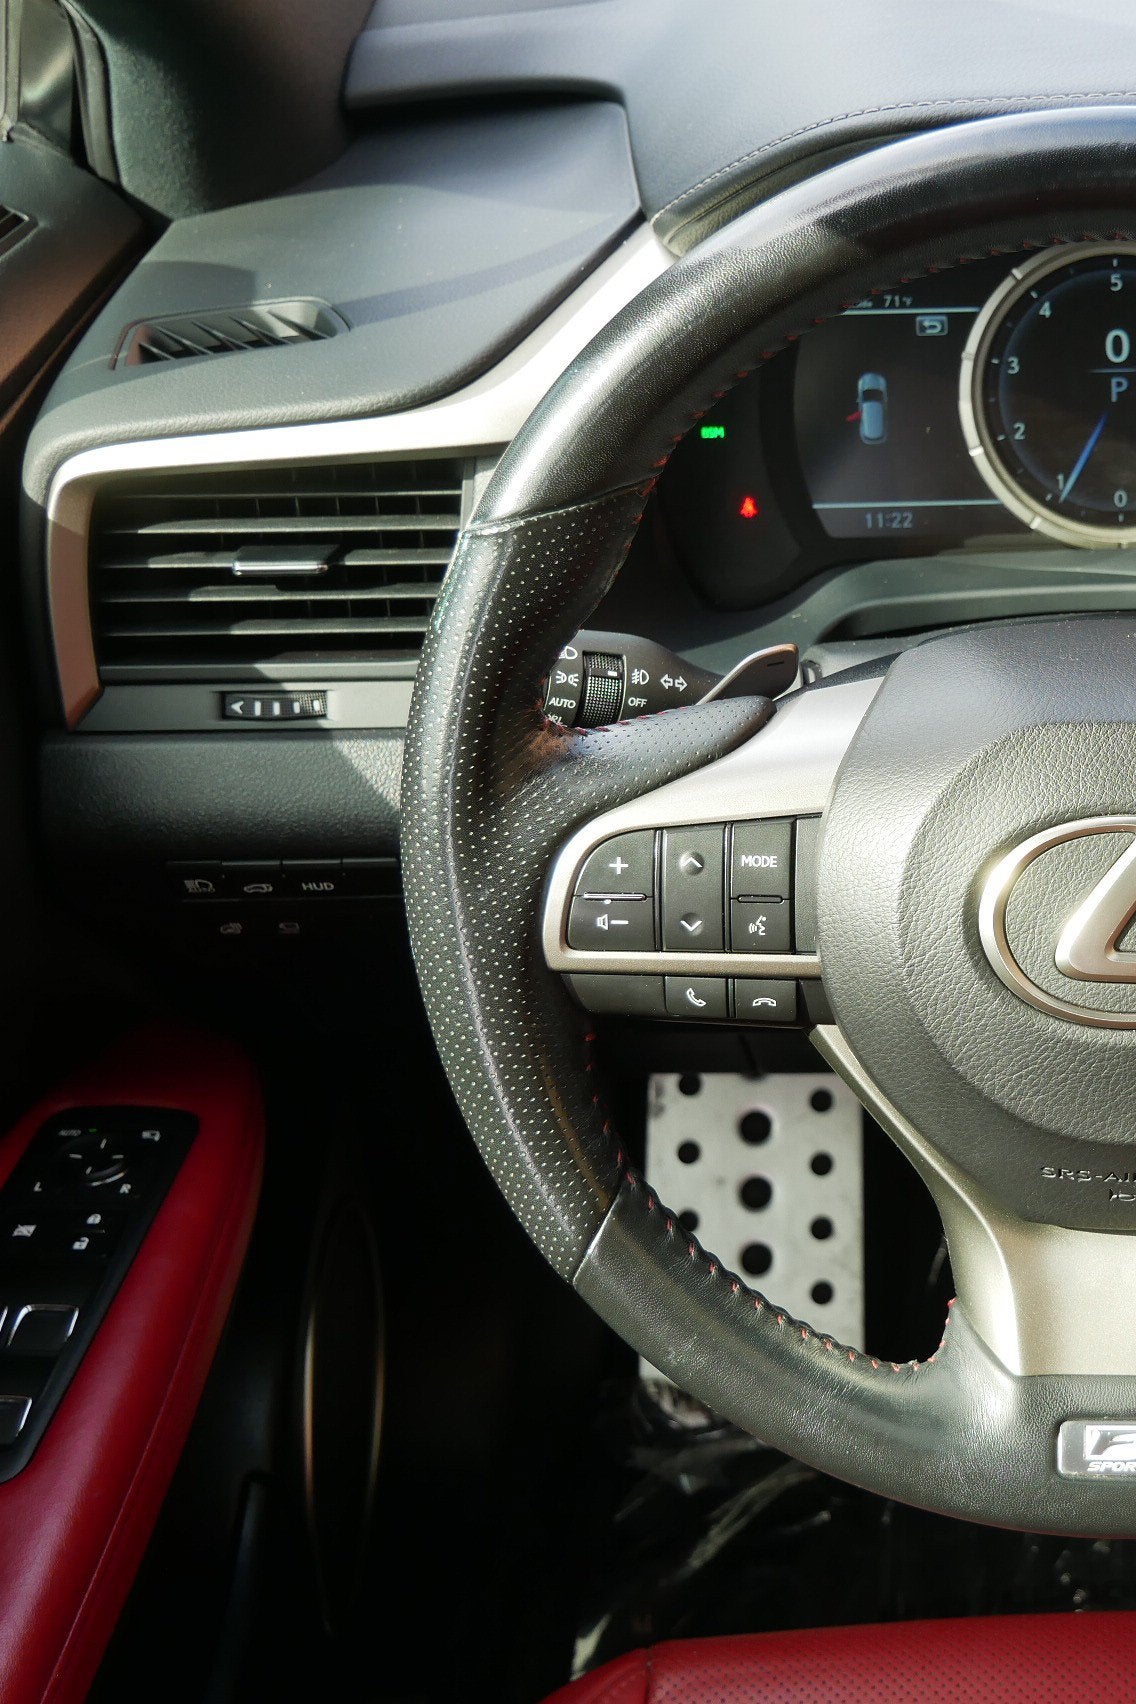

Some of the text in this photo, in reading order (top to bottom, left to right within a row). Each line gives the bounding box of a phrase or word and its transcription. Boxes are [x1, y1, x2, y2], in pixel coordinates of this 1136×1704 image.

[1110, 274, 1123, 292] 5
[1038, 302, 1052, 318] 4
[1105, 328, 1130, 363] 0
[1006, 358, 1020, 375] 3
[1110, 375, 1129, 402] P
[1013, 422, 1026, 440] 2
[1055, 473, 1066, 490] 1
[1113, 490, 1128, 508] 0
[864, 513, 914, 528] 11:22
[549, 697, 576, 709] AUTO
[628, 697, 648, 708] OFF
[741, 855, 778, 868] MODE
[301, 881, 335, 892] HUD
[33, 1181, 43, 1192] L
[119, 1183, 131, 1194] R
